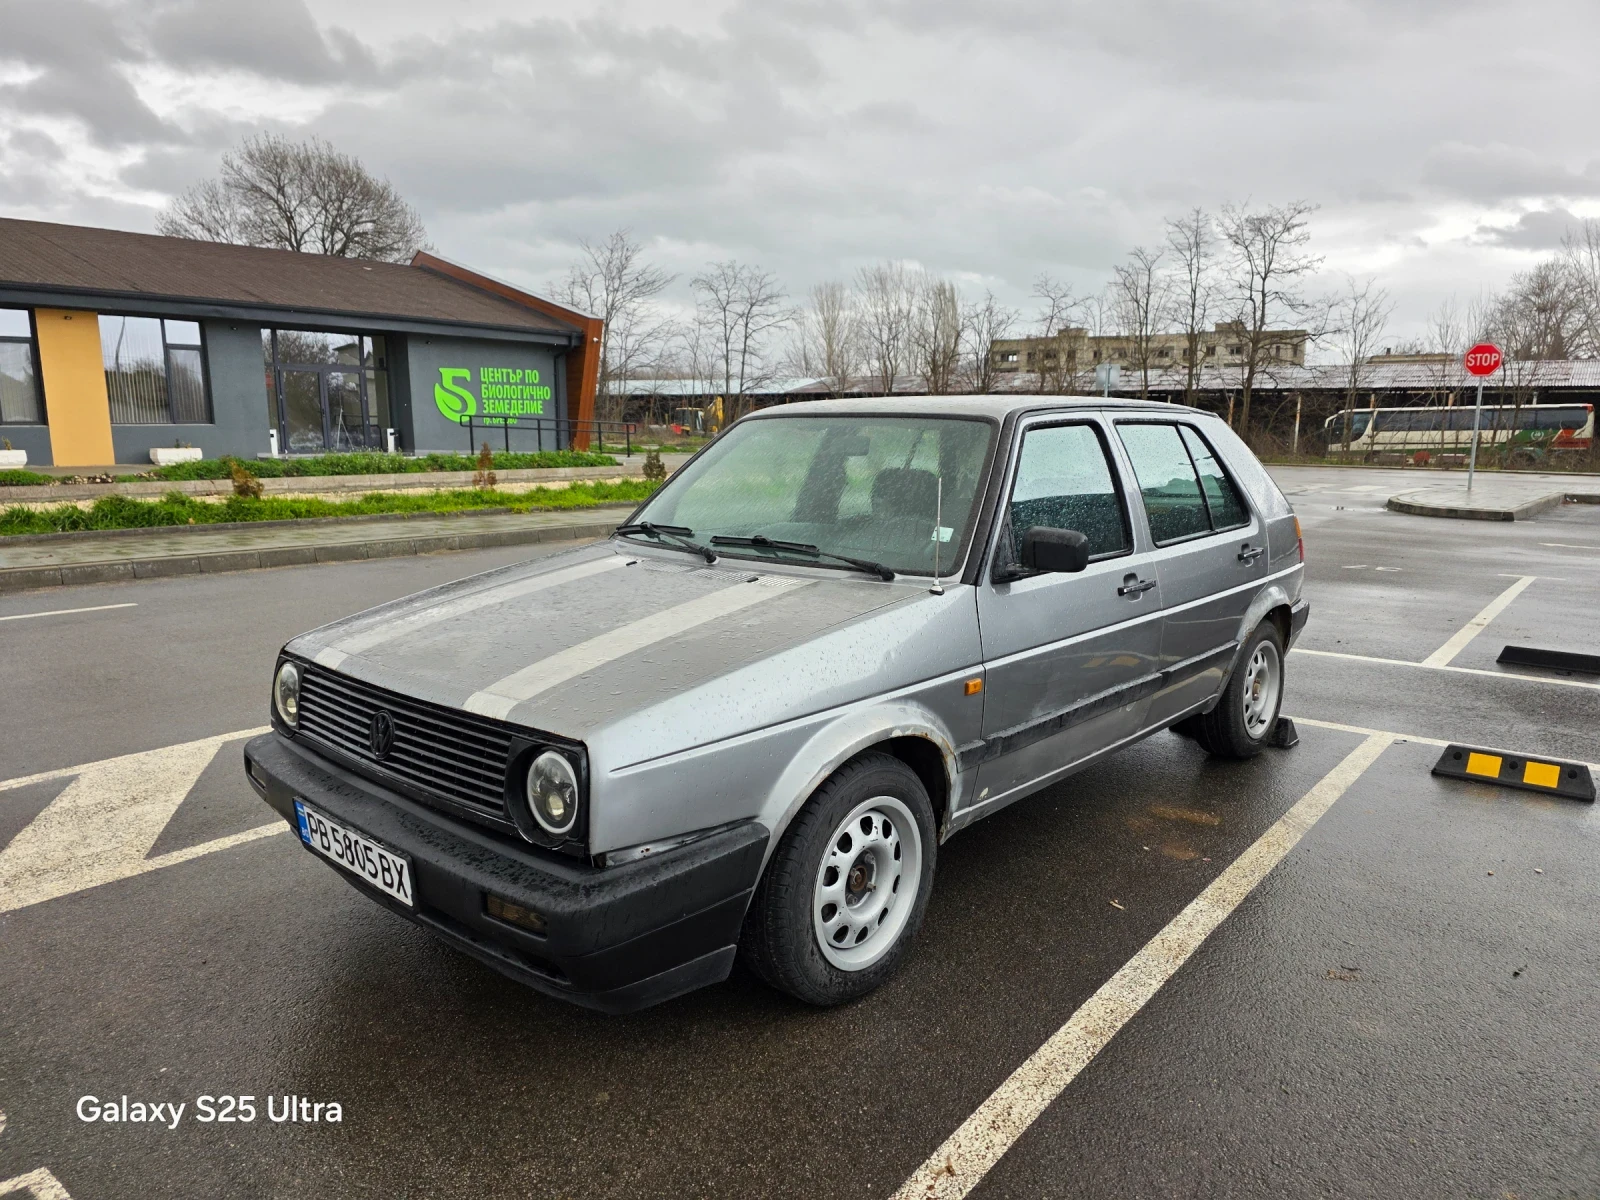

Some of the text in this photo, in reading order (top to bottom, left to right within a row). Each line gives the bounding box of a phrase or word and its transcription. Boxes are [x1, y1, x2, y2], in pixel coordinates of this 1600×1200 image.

[1467, 353, 1500, 367] STOP
[480, 367, 539, 384] ЦЕНТЪР ПО
[481, 383, 551, 400] БИОЛОГИЧНО
[482, 399, 544, 417] ЗЕМЕДЕЛИЕ
